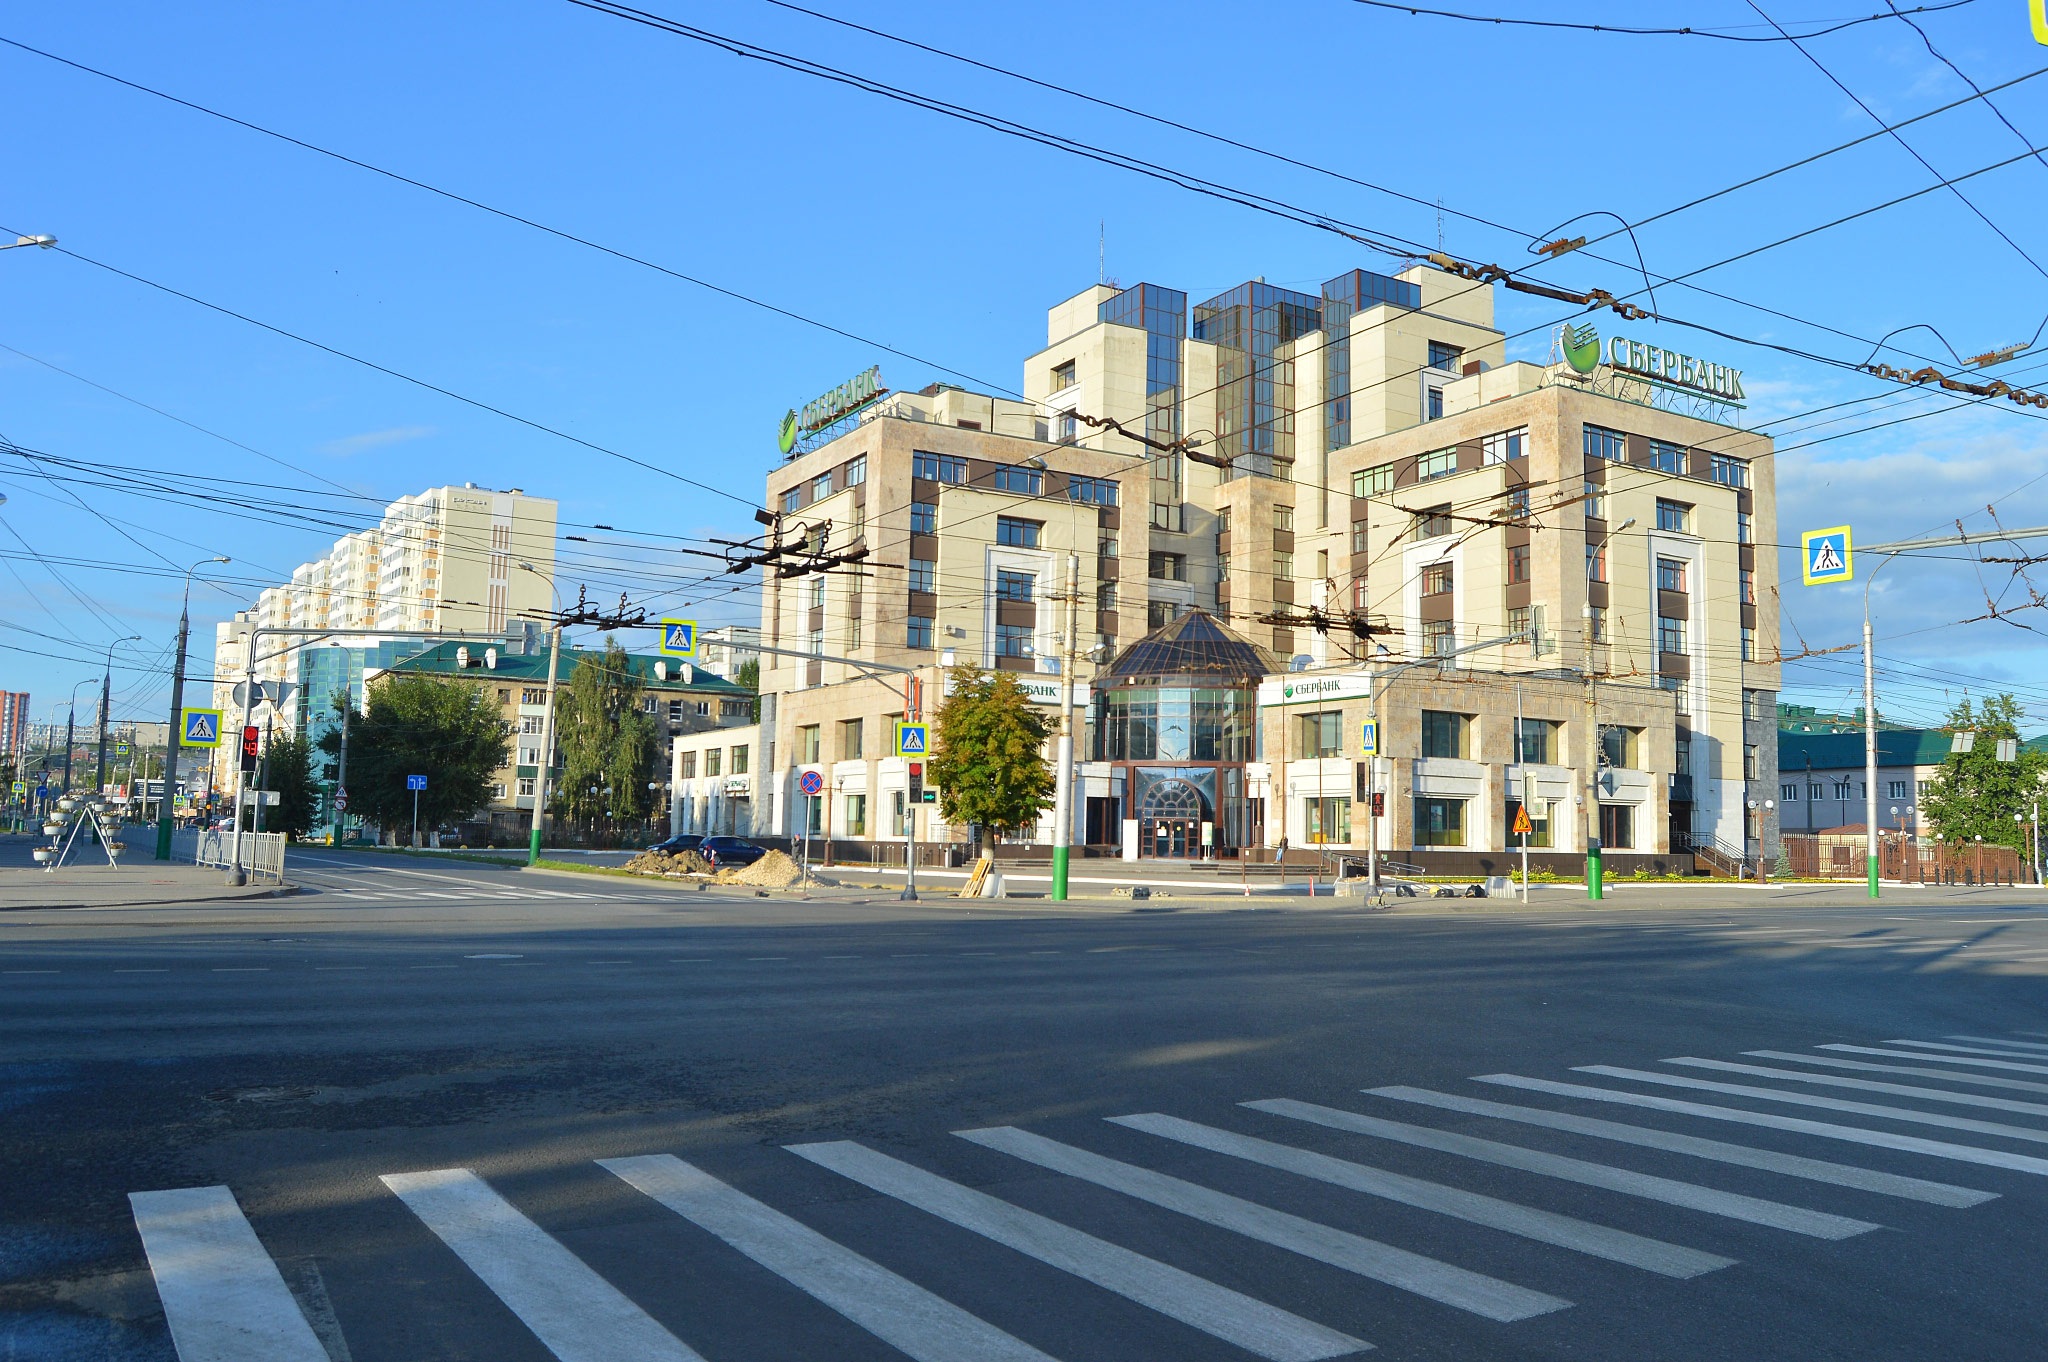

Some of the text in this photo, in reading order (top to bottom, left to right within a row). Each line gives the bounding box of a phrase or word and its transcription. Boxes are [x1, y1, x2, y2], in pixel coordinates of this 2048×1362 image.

[1608, 336, 1745, 399] СБЕРБАНК
[801, 365, 880, 430] СБЕРБАНК
[1295, 680, 1341, 695] СБЕРБАНК
[244, 742, 258, 756] 43
